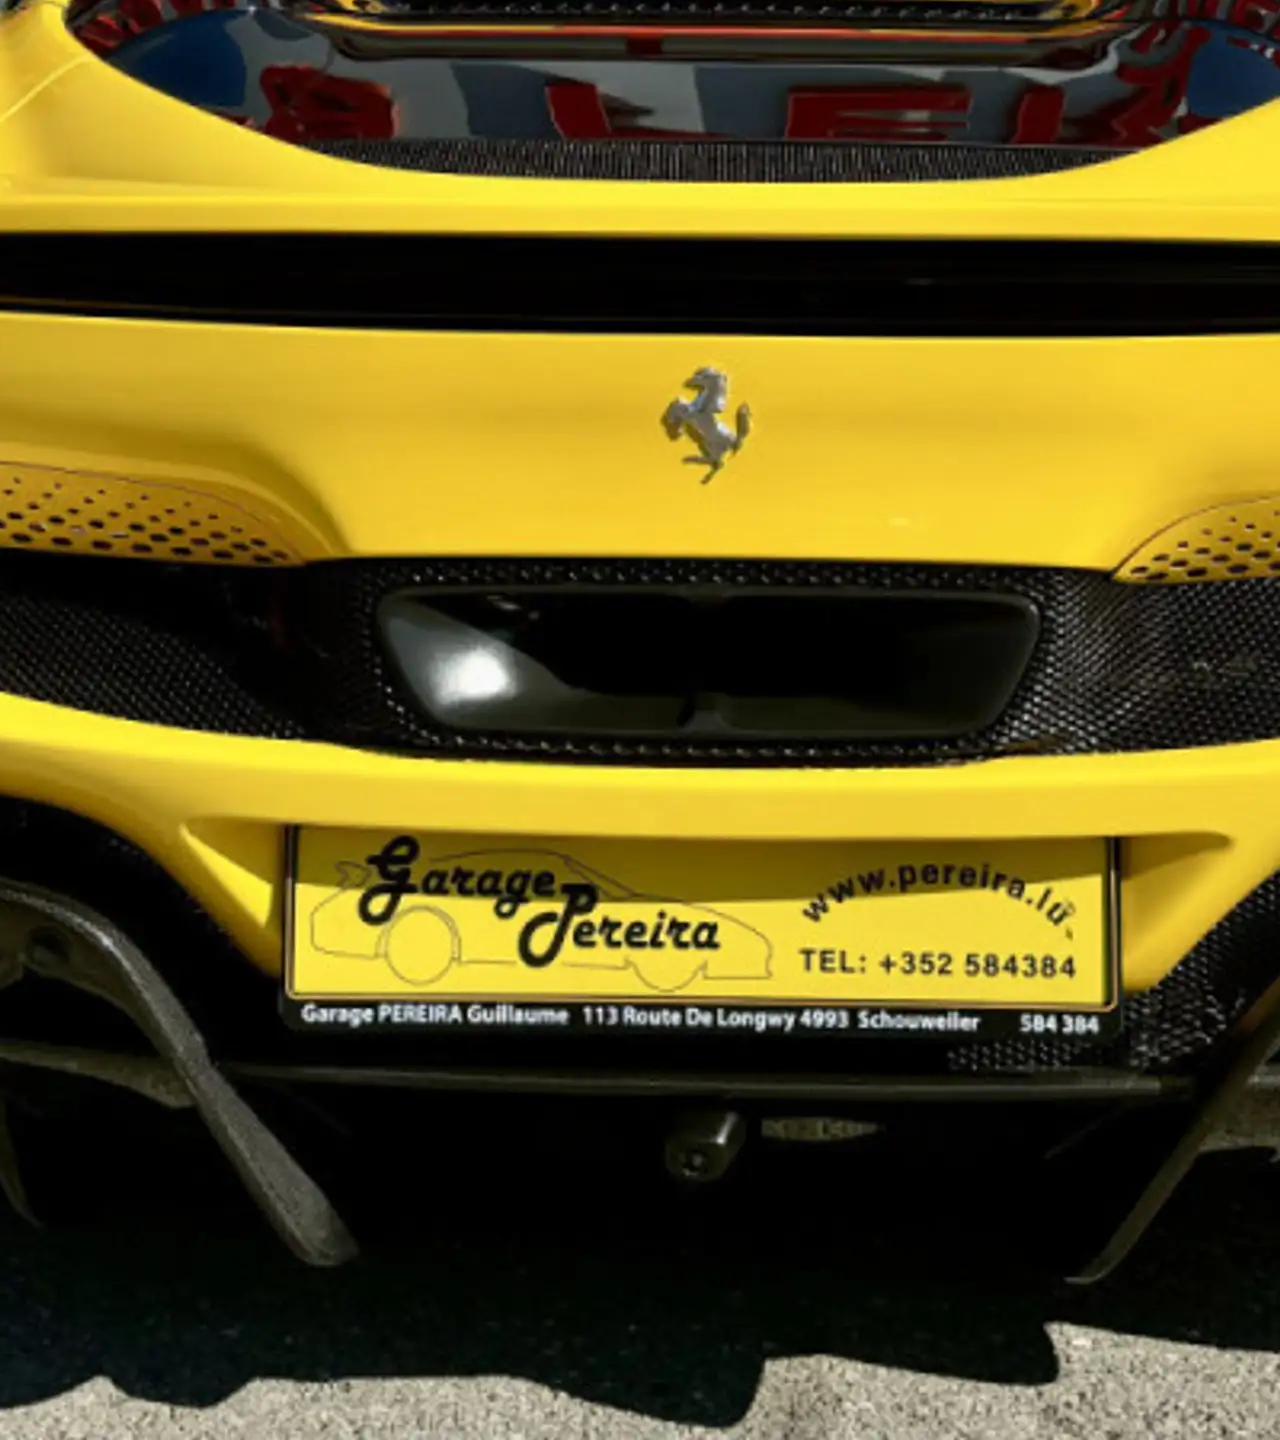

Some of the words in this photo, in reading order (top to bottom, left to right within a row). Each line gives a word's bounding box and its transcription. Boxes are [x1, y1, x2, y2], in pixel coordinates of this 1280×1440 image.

[358, 835, 557, 927] Garage
[802, 862, 1070, 926] www.pereira.lu
[518, 883, 721, 968] Pereira
[799, 948, 867, 974] TEL:
[879, 951, 953, 976] +352
[964, 953, 1077, 978] 584384
[301, 1002, 374, 1028] Garage
[378, 1002, 464, 1024] PEREIRA
[467, 1005, 570, 1026] Guillaume
[584, 1006, 619, 1026] 113
[623, 1006, 681, 1027] Route
[685, 1008, 713, 1027] De
[717, 1008, 796, 1033] Longwy
[799, 1009, 850, 1029] 4993
[857, 1010, 981, 1032] Schouweiler
[1020, 1013, 1058, 1033] 584
[1061, 1014, 1100, 1035] 384
